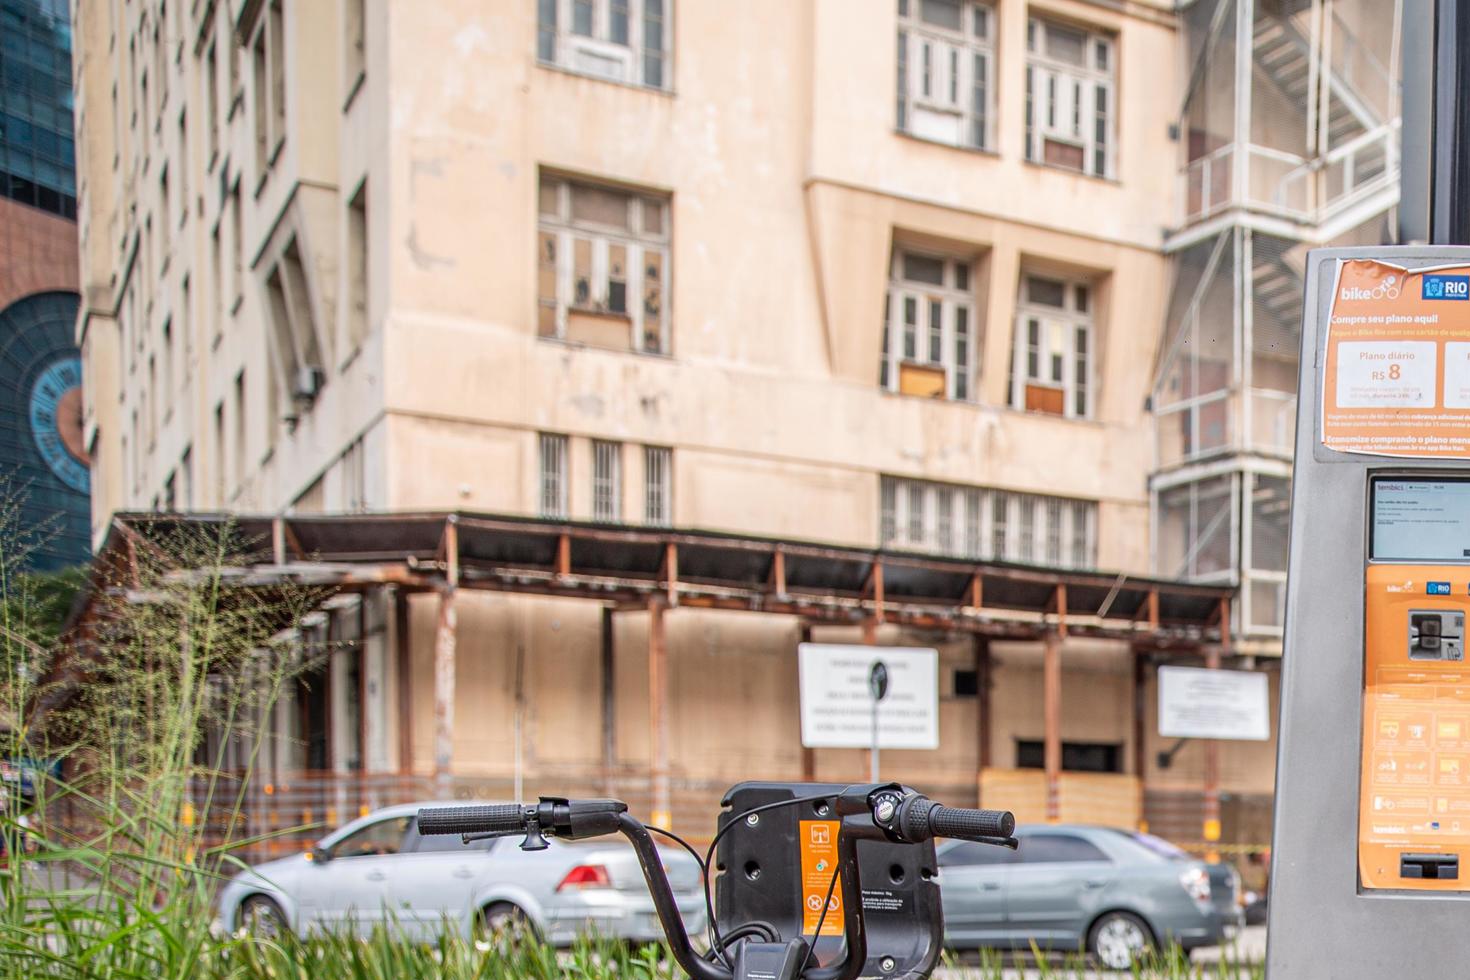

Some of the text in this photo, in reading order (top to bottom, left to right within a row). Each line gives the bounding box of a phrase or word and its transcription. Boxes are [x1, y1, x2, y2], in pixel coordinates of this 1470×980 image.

[1341, 287, 1371, 300] bike
[1445, 282, 1468, 294] RIO
[1332, 315, 1365, 325] Compre
[1386, 315, 1413, 325] plano
[1414, 315, 1438, 325] aqui!
[1360, 352, 1415, 360] Plano diário
[1372, 363, 1401, 380] R$ 8
[1437, 584, 1450, 593] RIO
